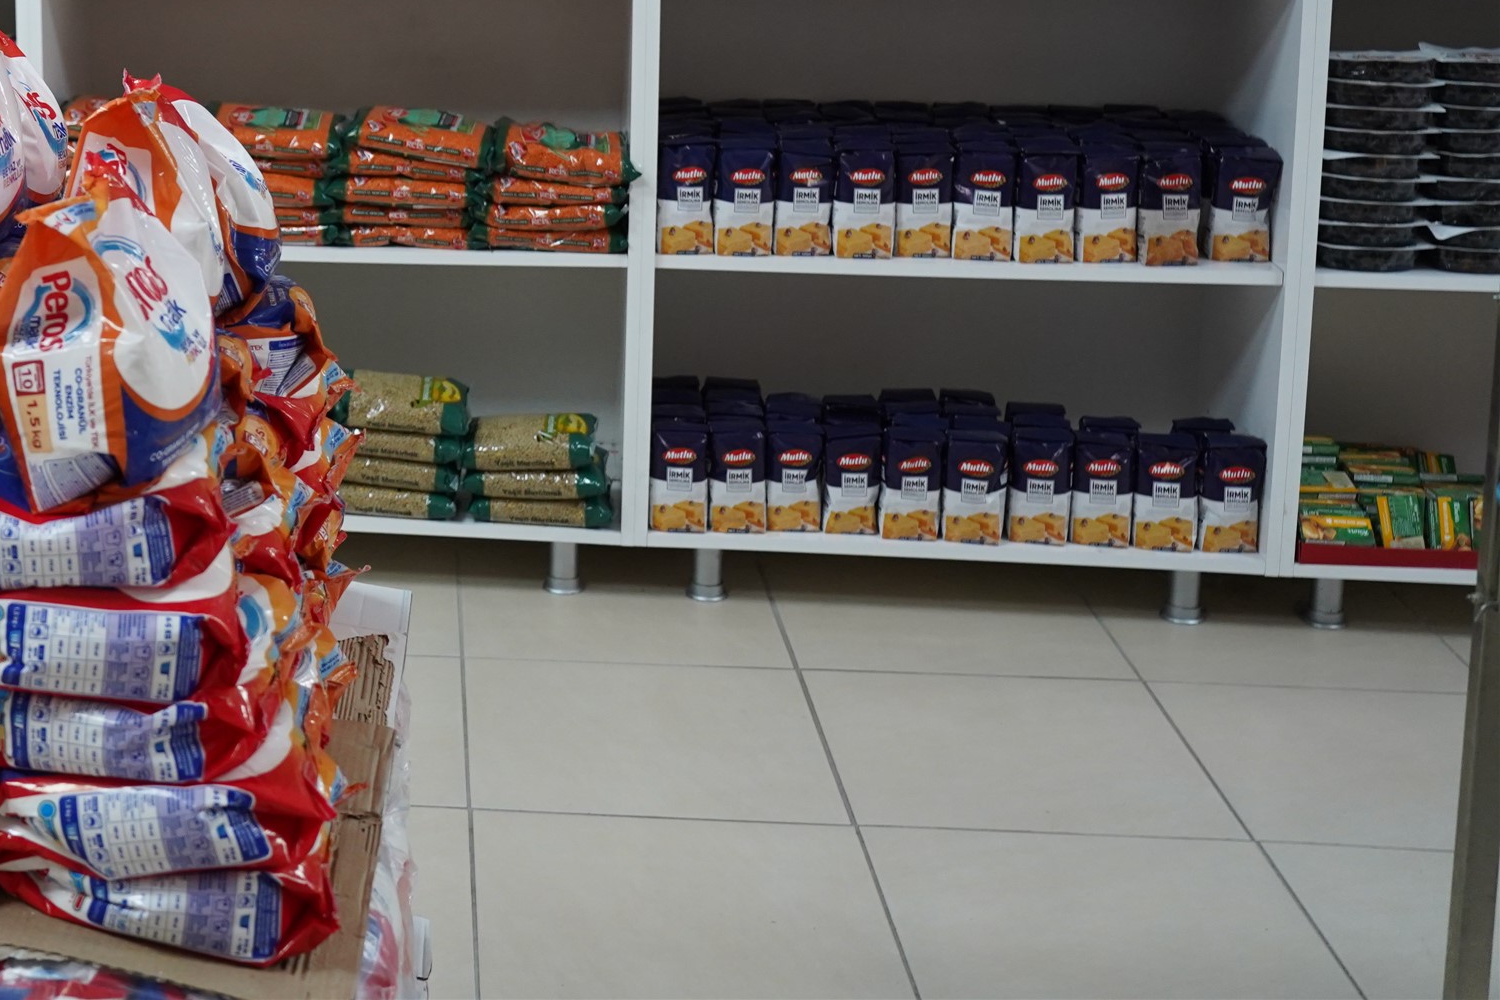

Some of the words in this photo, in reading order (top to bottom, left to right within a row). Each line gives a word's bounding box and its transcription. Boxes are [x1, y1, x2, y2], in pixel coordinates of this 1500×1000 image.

[675, 170, 703, 181] Mutlu
[733, 171, 762, 182] Mutlu
[792, 171, 819, 181] Mutlu
[852, 171, 882, 182] Mutlu
[910, 171, 940, 182] Mutlu
[973, 172, 1002, 185] Mutlu
[1098, 175, 1126, 187] Mutlu
[1034, 176, 1064, 188] Mutlu
[1159, 176, 1189, 187] Mutlu
[679, 190, 702, 200] İRMİK
[736, 192, 760, 201] İRMİK
[795, 191, 818, 201] İRMİK
[855, 192, 879, 201] İRMİK
[914, 192, 937, 201] İRMİK
[975, 193, 1000, 202] İRMİK
[1039, 196, 1062, 206] İRMİK
[1103, 196, 1125, 206] İRMİK
[1164, 196, 1188, 207] İRMİK
[40, 271, 71, 352] Peros
[21, 368, 31, 389] 10
[53, 369, 66, 440] TEKNOLOJİSİ
[66, 385, 74, 419] ENZİM
[75, 368, 88, 435] CO-GRANÜL
[26, 400, 40, 428] 1,5
[32, 430, 42, 449] kg
[664, 450, 694, 461] Mutlu
[724, 452, 752, 463] Mutlu
[779, 452, 809, 463] Mutlu
[839, 456, 869, 467] Mutlu
[900, 459, 930, 471] Mutlu
[959, 462, 991, 474] Mutlu
[1087, 462, 1118, 473] Mutlu
[668, 470, 691, 479] İRMİK
[728, 472, 751, 481] İRMİK
[1220, 468, 1252, 481] Mutlu
[843, 476, 866, 485] İRMİK
